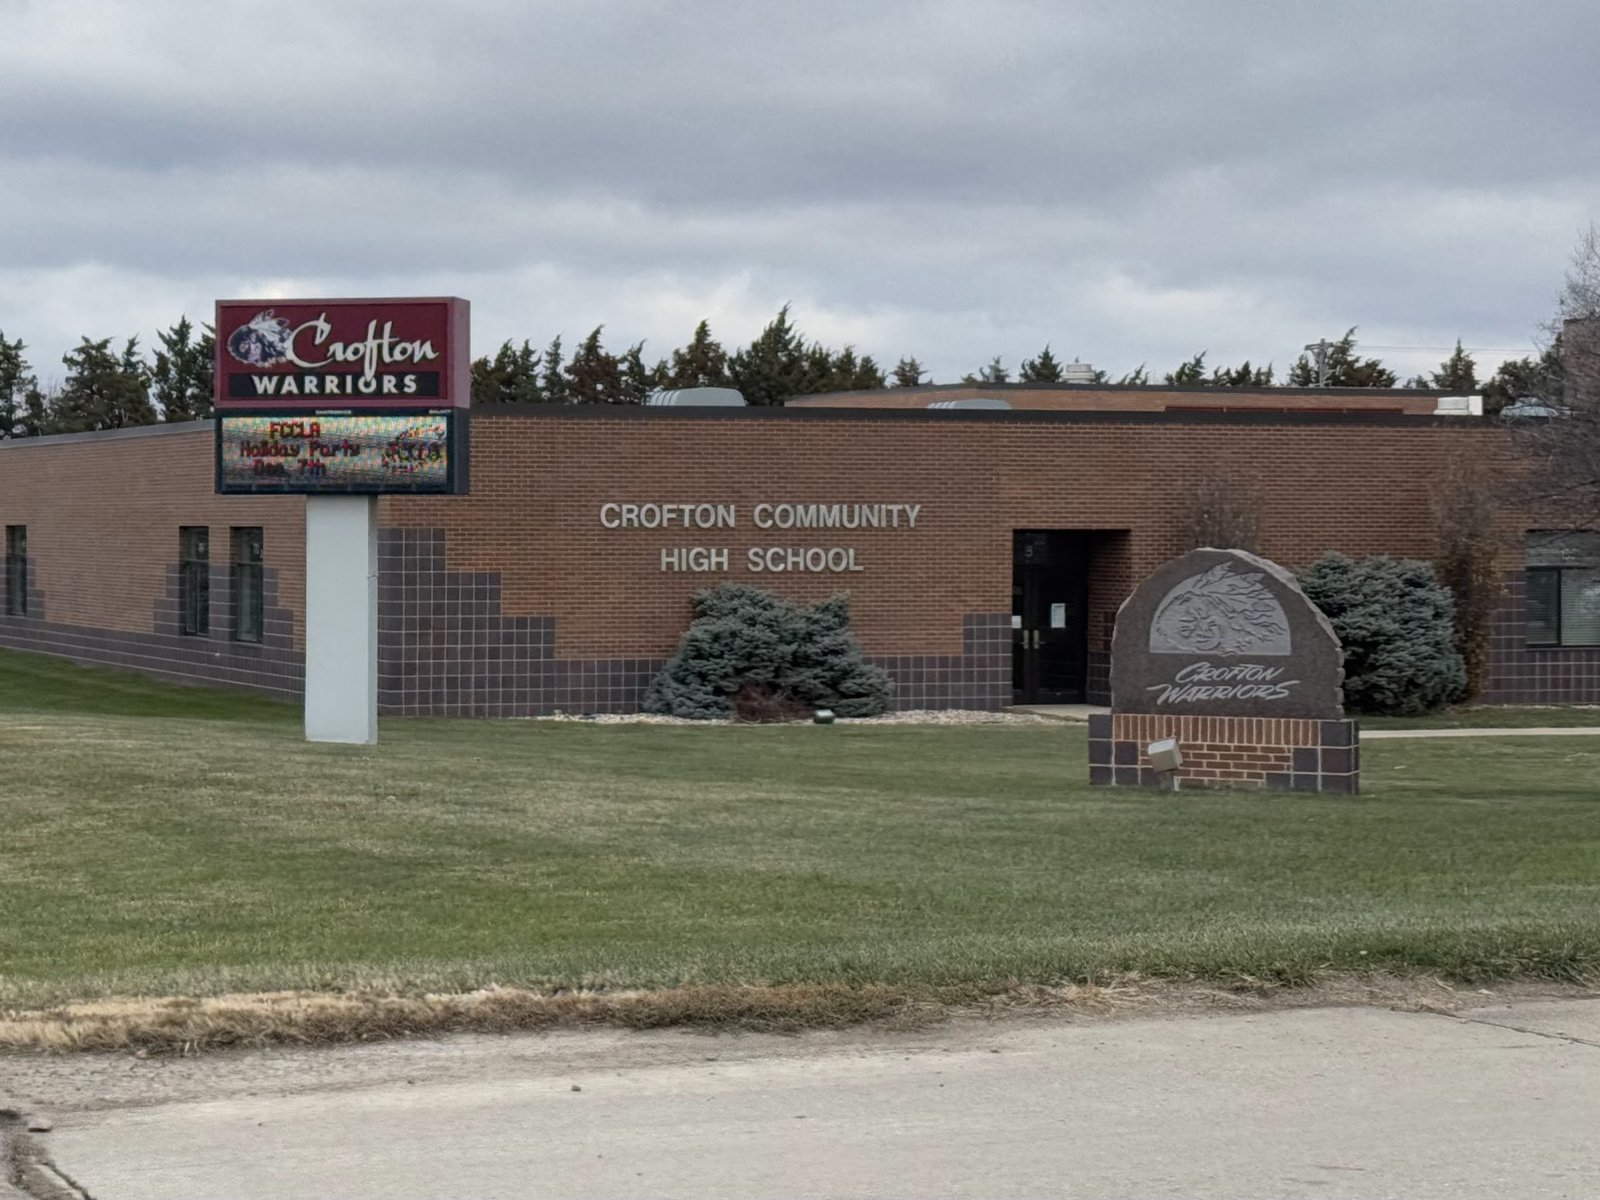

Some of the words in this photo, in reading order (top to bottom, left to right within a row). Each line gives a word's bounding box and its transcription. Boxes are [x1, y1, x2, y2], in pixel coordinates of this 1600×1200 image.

[285, 312, 440, 382] Crofton
[252, 374, 418, 395] WARRIORS
[269, 421, 321, 438] FCCLA
[240, 440, 300, 457] Holiday
[309, 440, 360, 457] Party
[600, 503, 736, 529] CROFTON
[754, 503, 922, 529] COMMUNITY
[660, 548, 729, 572] HIGH
[747, 547, 864, 573] SCHOOL
[1175, 661, 1285, 684] CROFTON
[1146, 680, 1301, 705] WARRIORS
